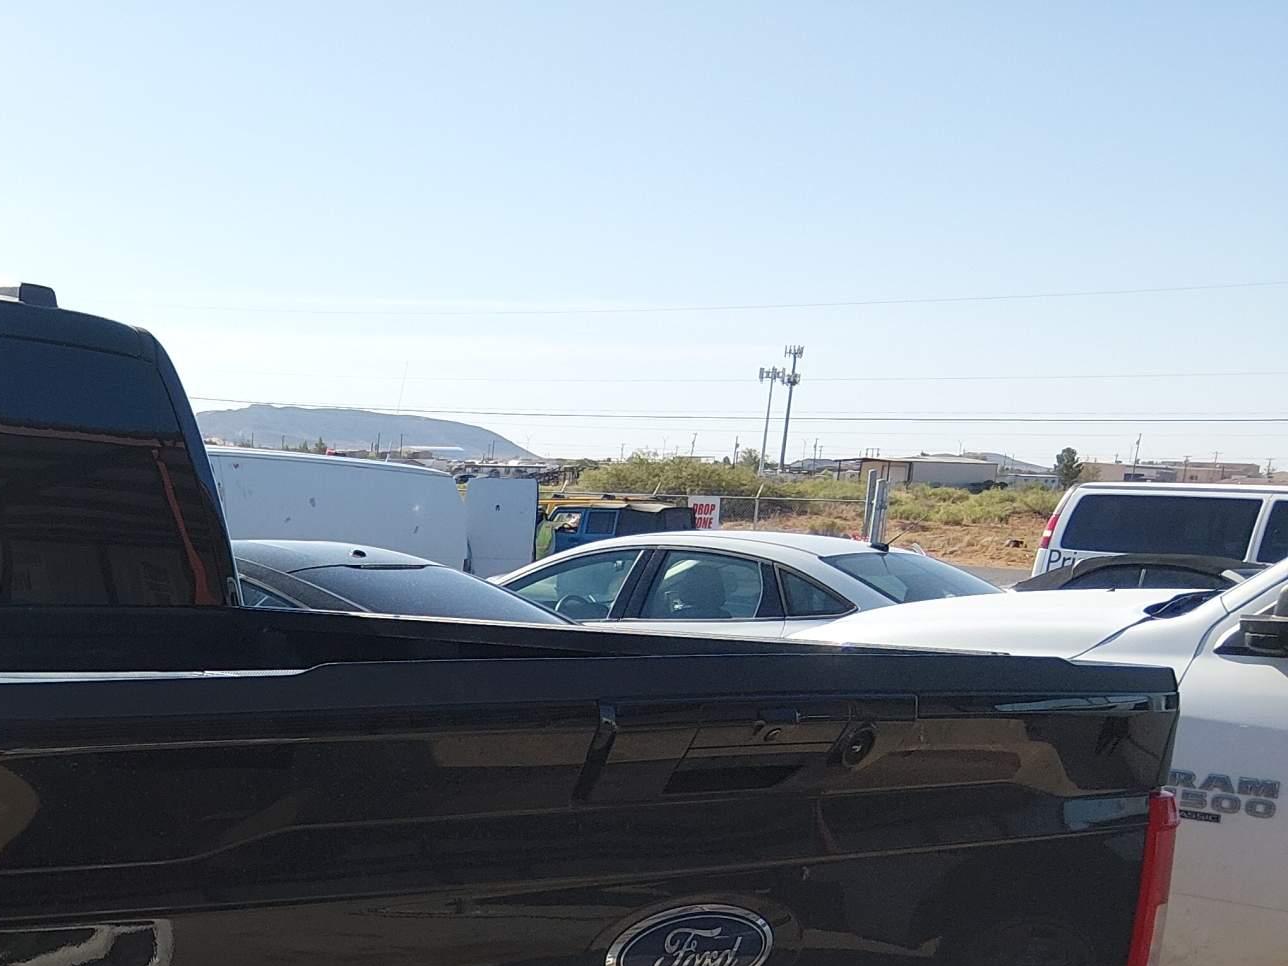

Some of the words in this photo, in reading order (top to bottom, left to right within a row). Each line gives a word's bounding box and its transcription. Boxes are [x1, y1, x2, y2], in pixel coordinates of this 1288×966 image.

[693, 503, 716, 516] DROP
[695, 516, 714, 529] ONE
[1046, 549, 1078, 573] Pri
[1168, 768, 1280, 799] RAM
